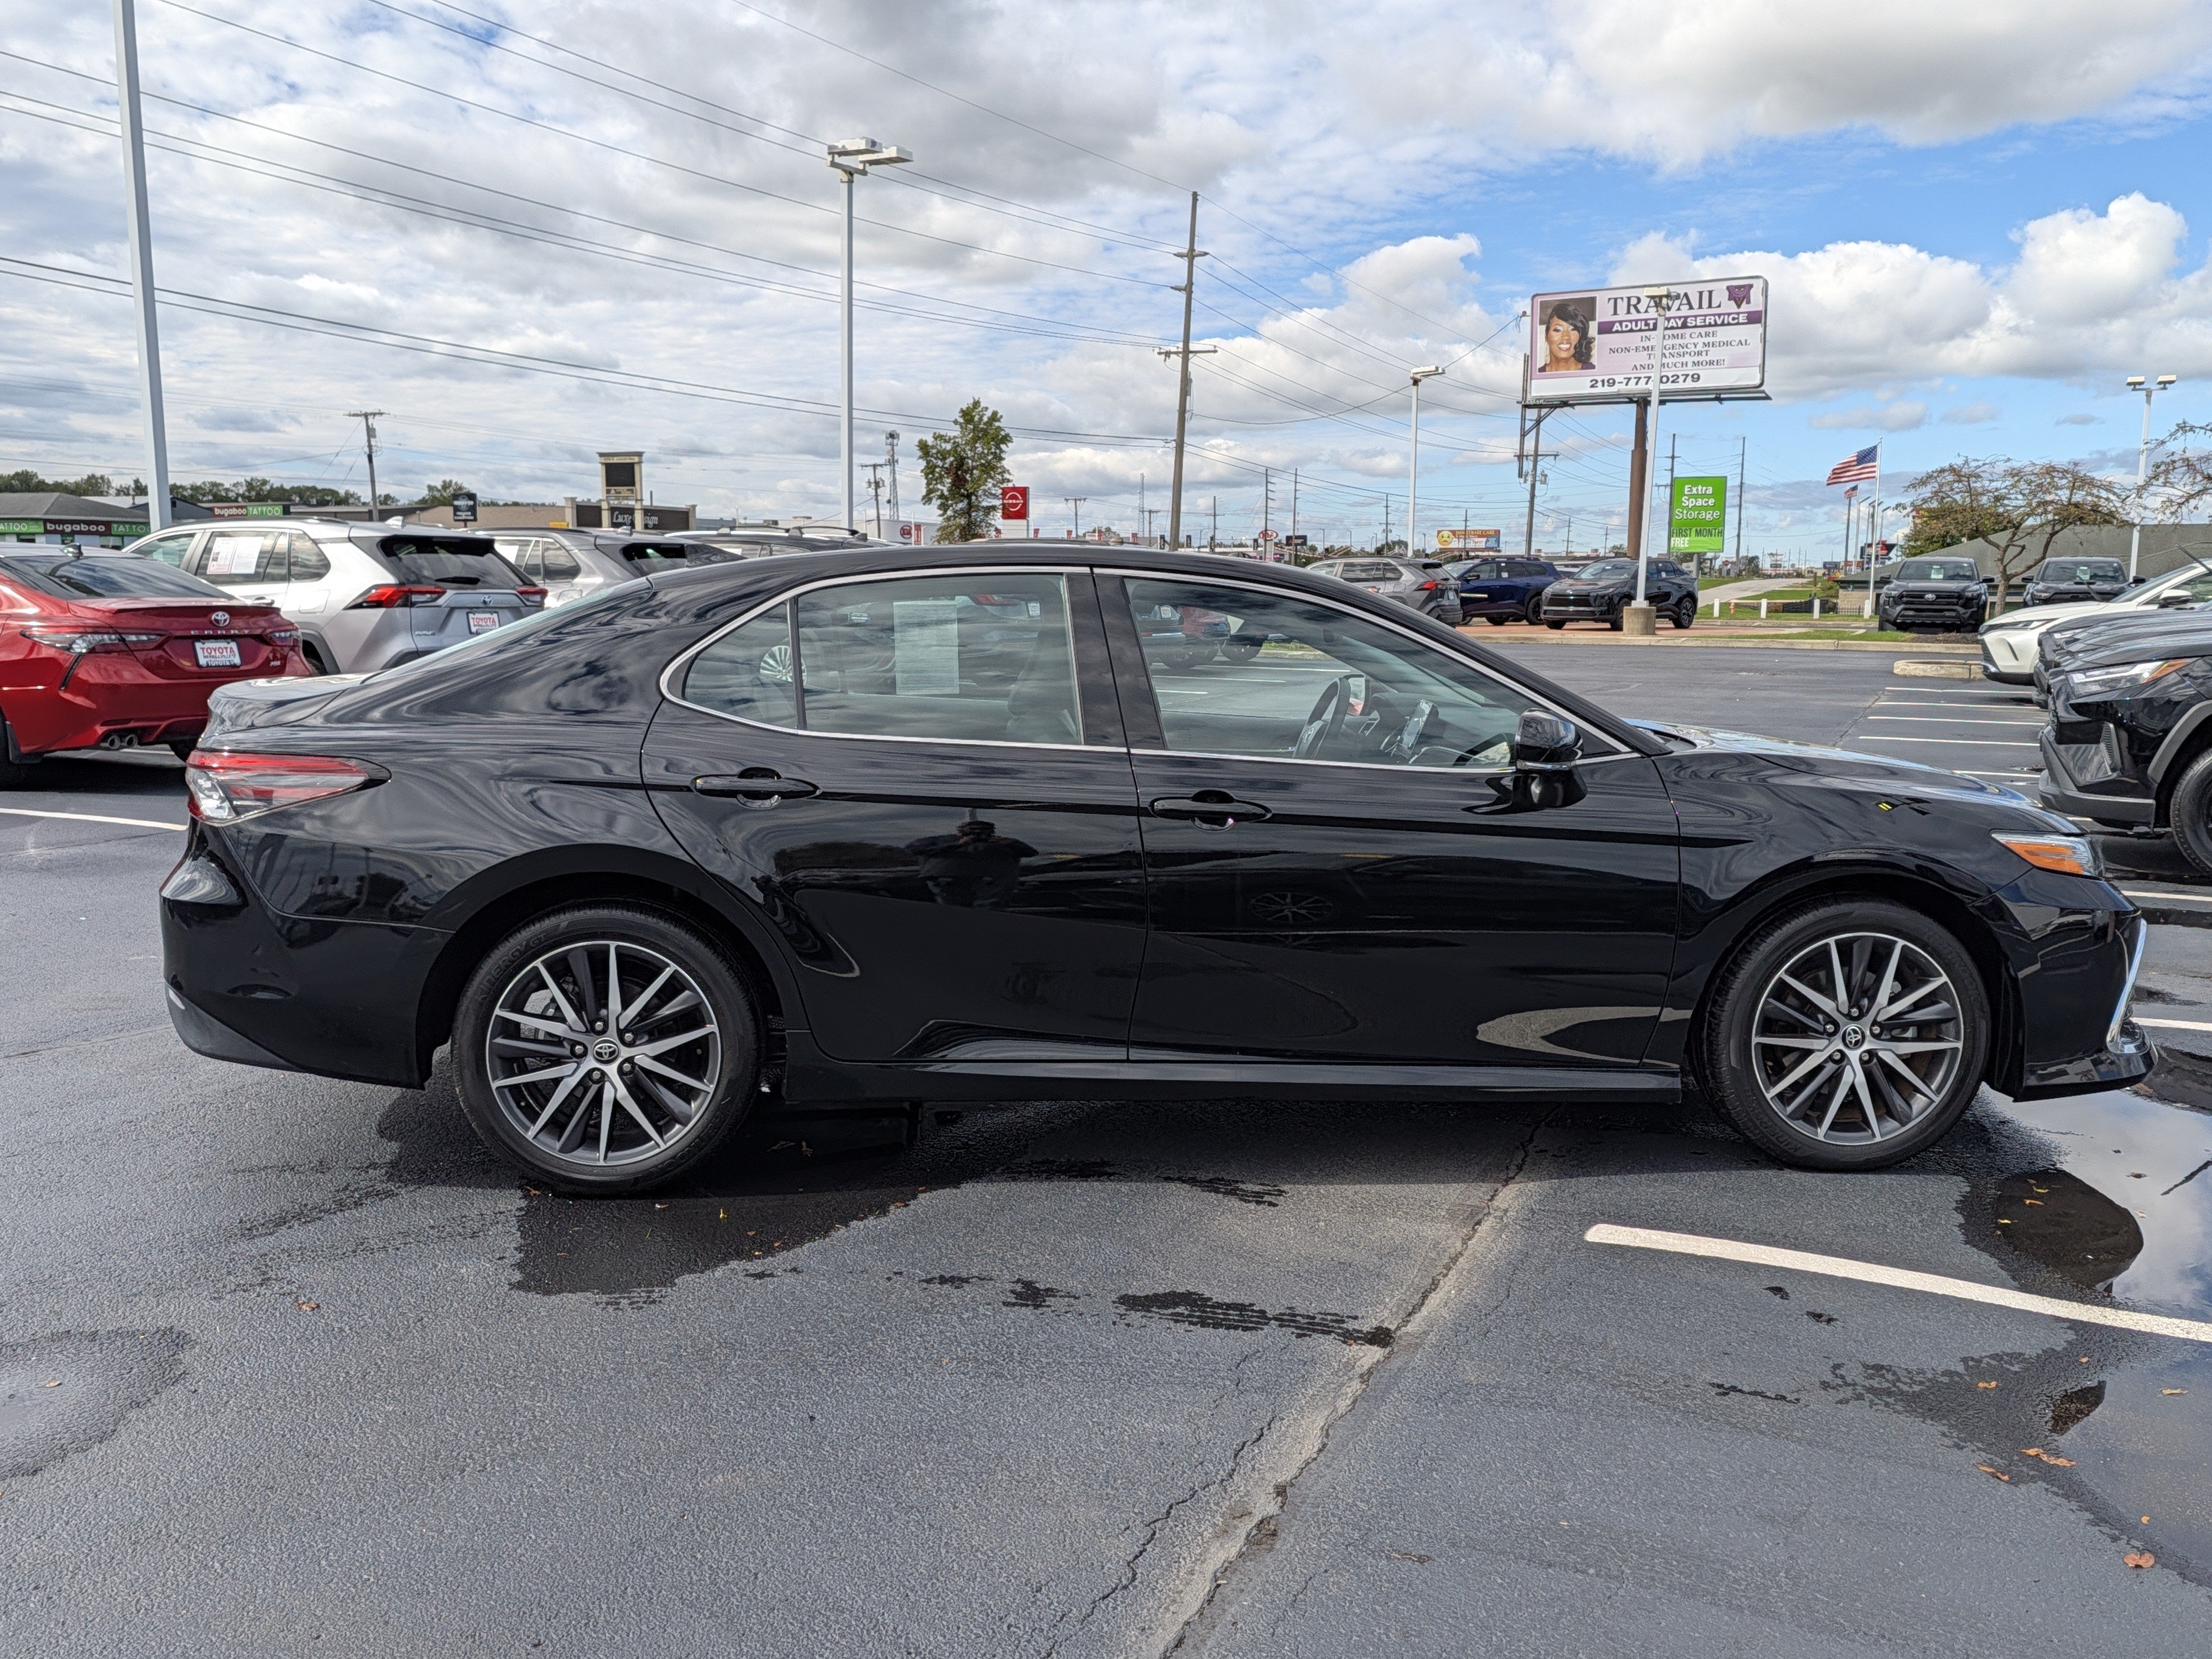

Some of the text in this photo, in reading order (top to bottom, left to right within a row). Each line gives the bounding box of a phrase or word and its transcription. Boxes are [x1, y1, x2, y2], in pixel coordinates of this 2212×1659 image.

[1608, 289, 1721, 316] TRAVAIL
[1612, 319, 1656, 332] ADULT
[1687, 313, 1749, 327] SERVICE
[1640, 330, 1718, 342] IN-OME CARE
[1608, 338, 1751, 354] NON-EMEGENCY MEDICAL
[1631, 363, 1655, 372] AND
[1691, 358, 1725, 368] MORE!
[1684, 484, 1713, 495] Extra
[1681, 495, 1715, 509] Space
[214, 507, 281, 517] bugaboo TATTOO
[613, 511, 632, 525] Luxe
[1674, 508, 1720, 521] Storage
[0, 522, 28, 531] ATTOO
[46, 521, 106, 533] bugaboo
[1671, 528, 1723, 538] FIRST MONTH
[1671, 537, 1689, 547] FREE
[199, 646, 236, 656] TOYOTA
